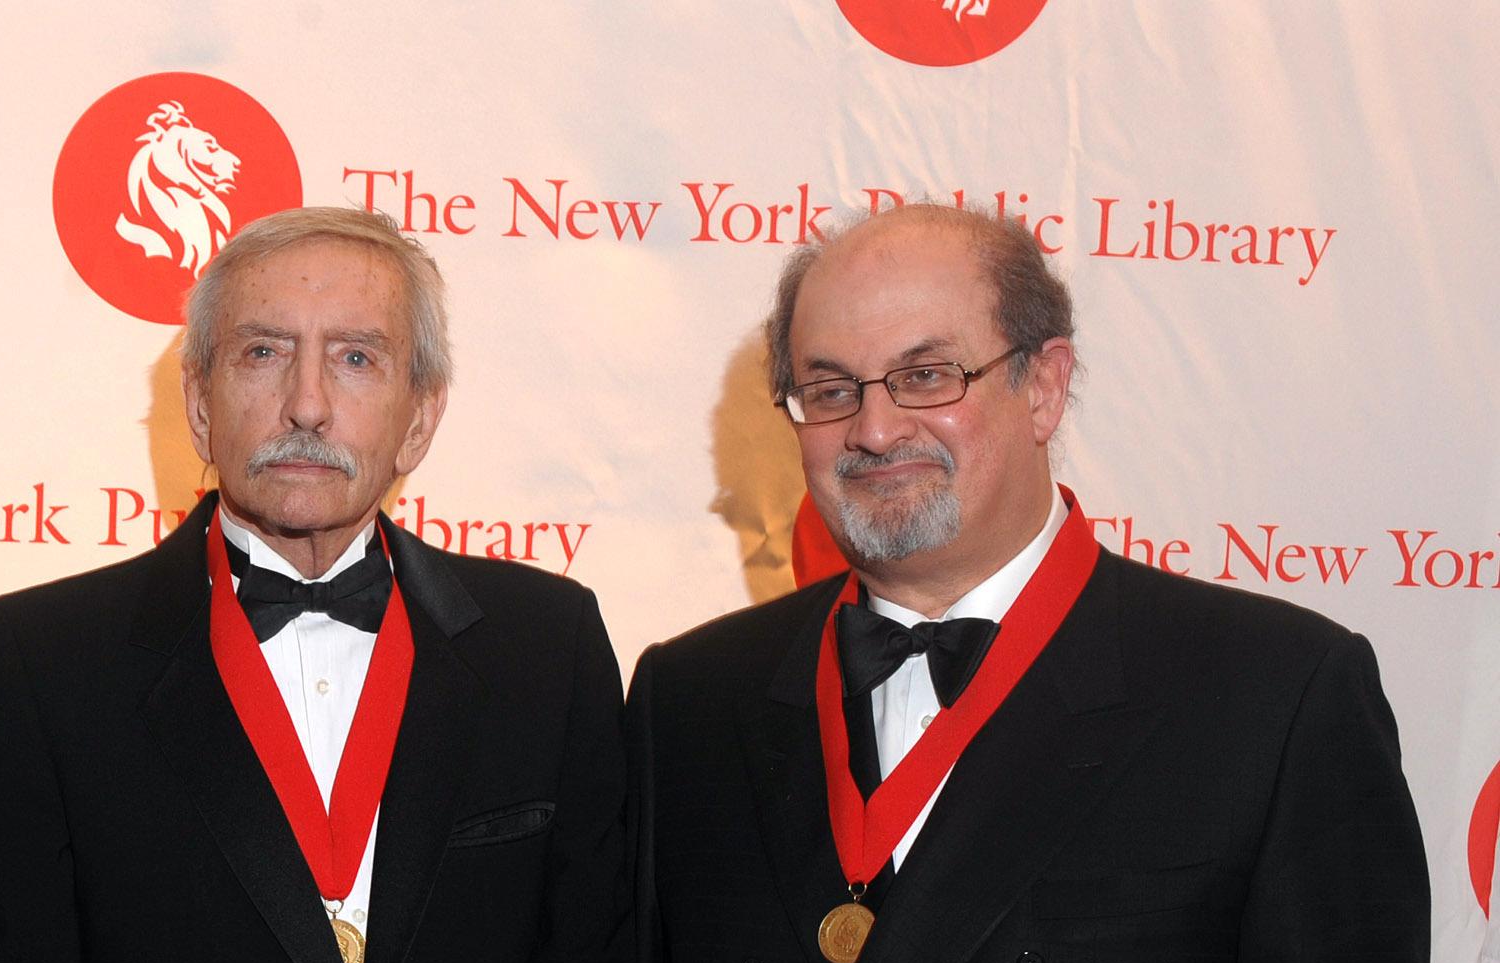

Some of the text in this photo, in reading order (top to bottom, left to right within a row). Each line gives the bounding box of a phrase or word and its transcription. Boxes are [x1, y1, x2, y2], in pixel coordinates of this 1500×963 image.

[342, 167, 476, 236] The
[502, 177, 662, 241] New
[681, 183, 833, 245] York
[1089, 198, 1338, 287] Library
[393, 495, 592, 578] ibrary
[1214, 523, 1369, 585] New
[1386, 530, 1500, 589] Yor
